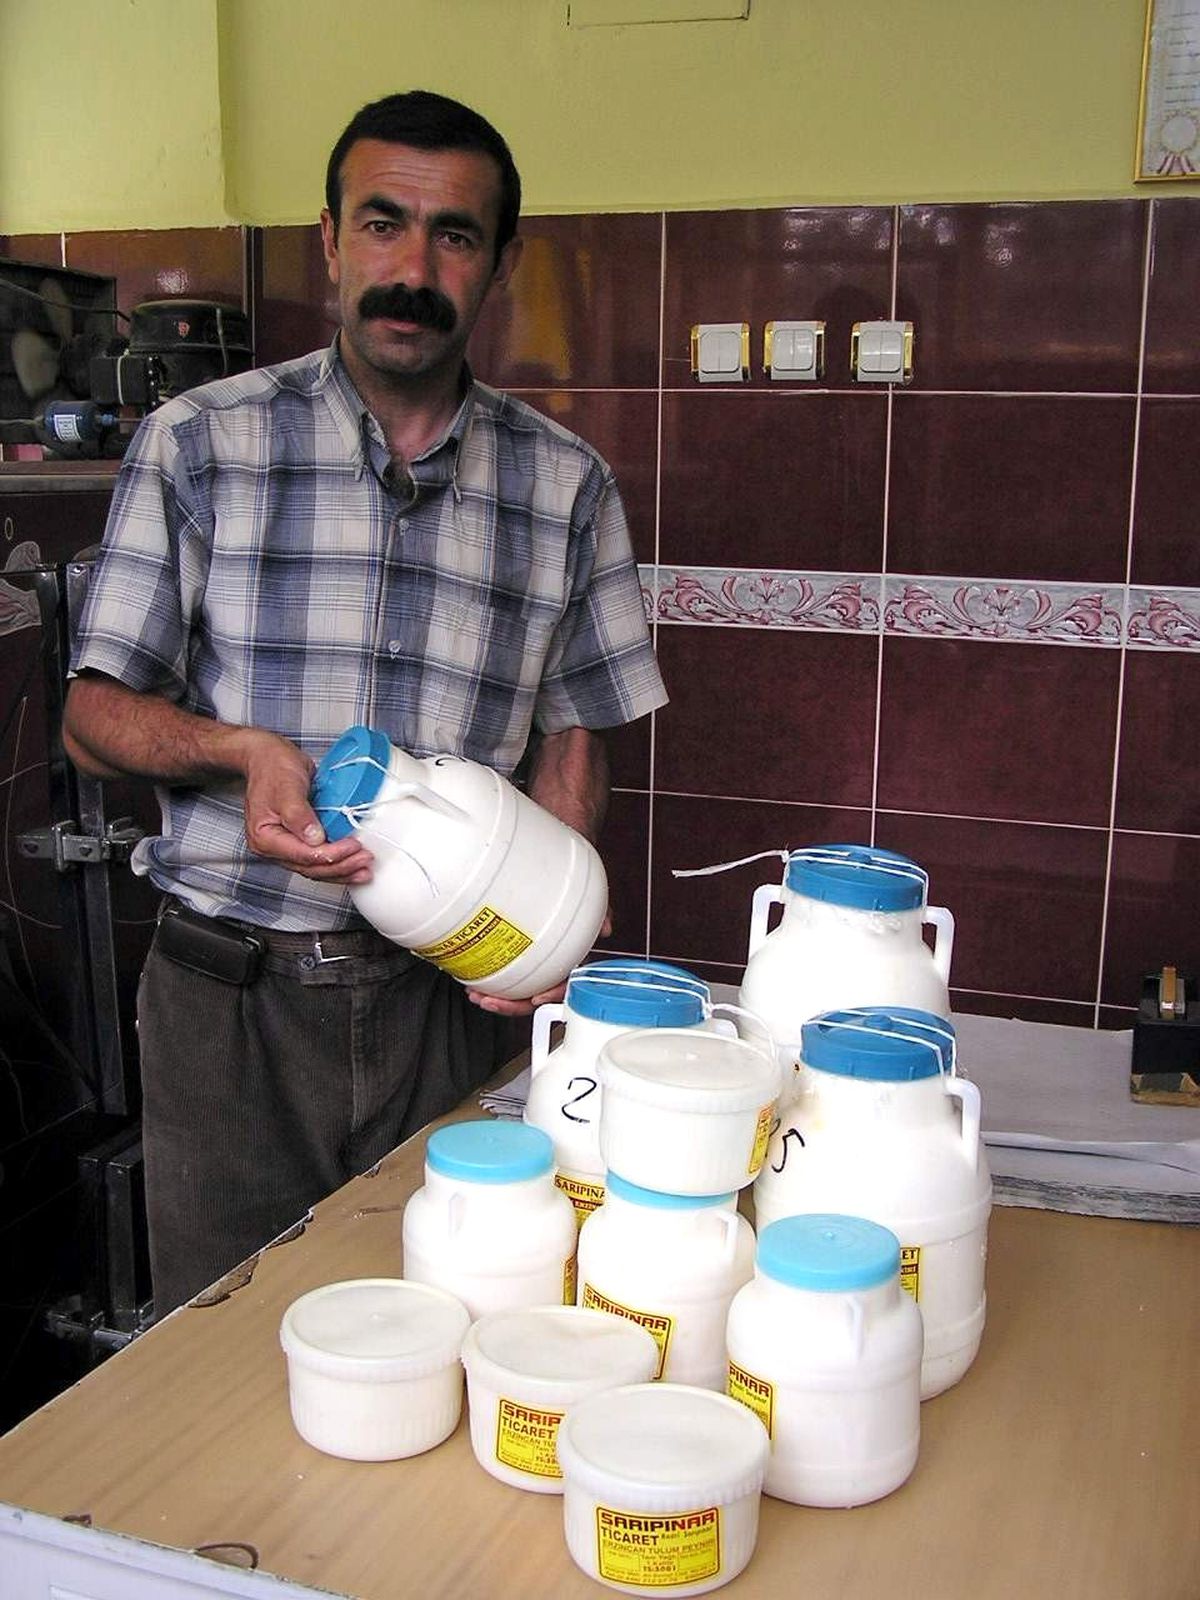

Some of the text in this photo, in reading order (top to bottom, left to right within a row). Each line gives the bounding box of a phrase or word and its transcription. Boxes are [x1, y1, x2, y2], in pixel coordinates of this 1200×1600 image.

[561, 1076, 598, 1123] 2
[555, 1178, 606, 1199] SARIPINA
[729, 1365, 770, 1398] PINAR
[503, 1404, 561, 1427] SARIP
[601, 1511, 716, 1533] SARIPINAR
